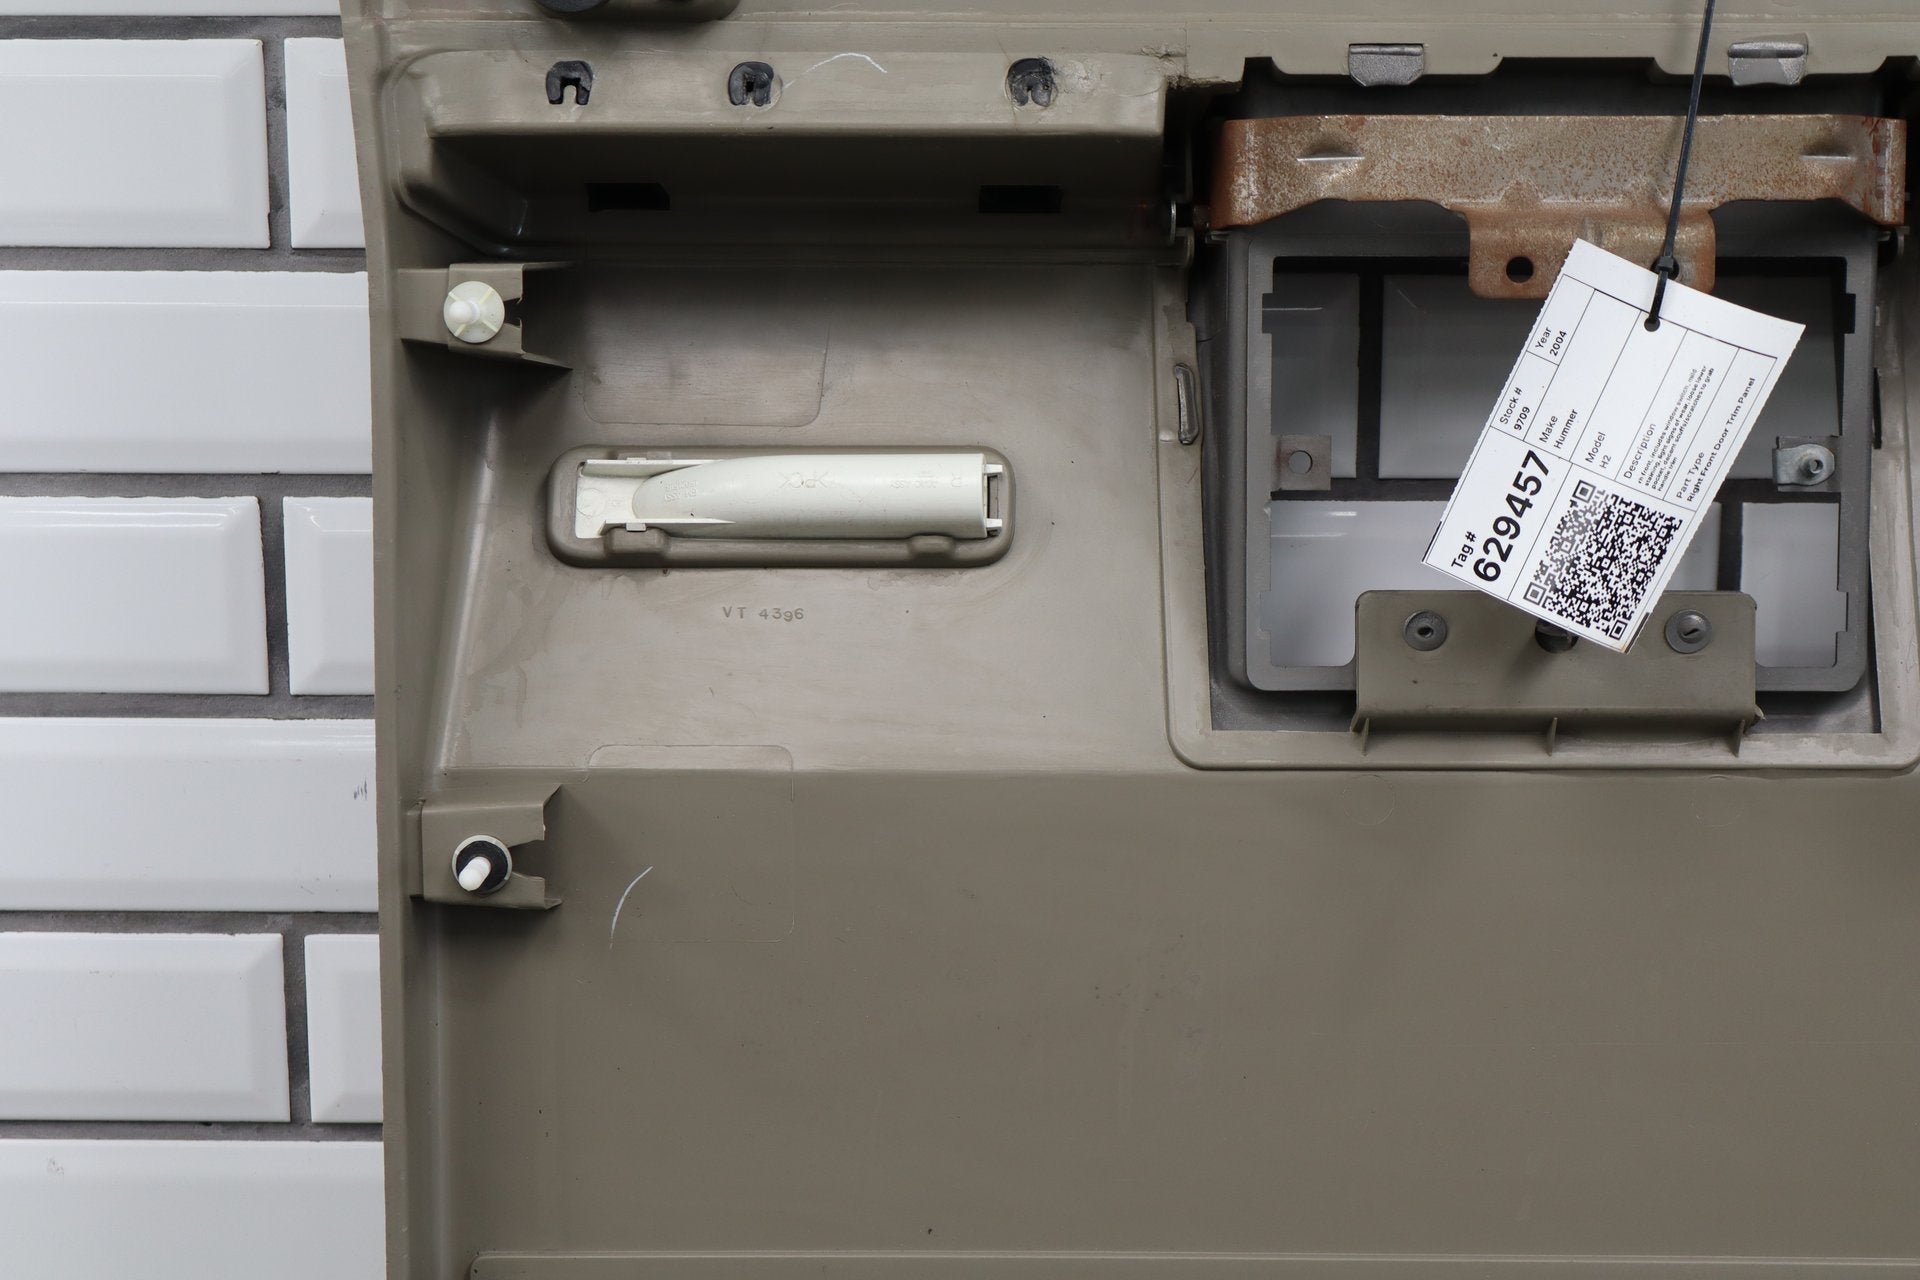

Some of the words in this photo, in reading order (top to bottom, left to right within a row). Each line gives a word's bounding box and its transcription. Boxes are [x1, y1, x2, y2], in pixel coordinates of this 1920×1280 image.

[1534, 327, 1552, 348] Year
[1549, 330, 1567, 357] 2004
[1500, 396, 1519, 425] Stock
[1513, 386, 1523, 396] #
[1513, 406, 1531, 431] 9709
[1538, 415, 1559, 443] Make
[1553, 408, 1578, 450] Hummer
[1644, 460, 1662, 487] staining,
[1665, 427, 1677, 445] signs
[1695, 365, 1707, 384] lower
[1650, 431, 1667, 459] includes
[1663, 406, 1679, 431] window
[1651, 466, 1667, 490] pocket,
[1663, 443, 1677, 466] decent
[1704, 367, 1715, 383] grab
[1686, 477, 1704, 502] Right
[1699, 451, 1718, 477] Front
[1713, 427, 1729, 451] Door
[1725, 405, 1742, 425] Trim
[1737, 377, 1756, 404] Panel
[1584, 431, 1606, 464] Model
[1599, 454, 1612, 469] H2
[1623, 423, 1657, 480] Description
[1656, 470, 1671, 492] handle
[1675, 478, 1692, 499] Part
[1687, 451, 1705, 475] Type
[1472, 449, 1550, 582] 629457
[1450, 543, 1474, 568] Tag
[1464, 530, 1477, 543] #
[758, 608, 804, 622] 4396
